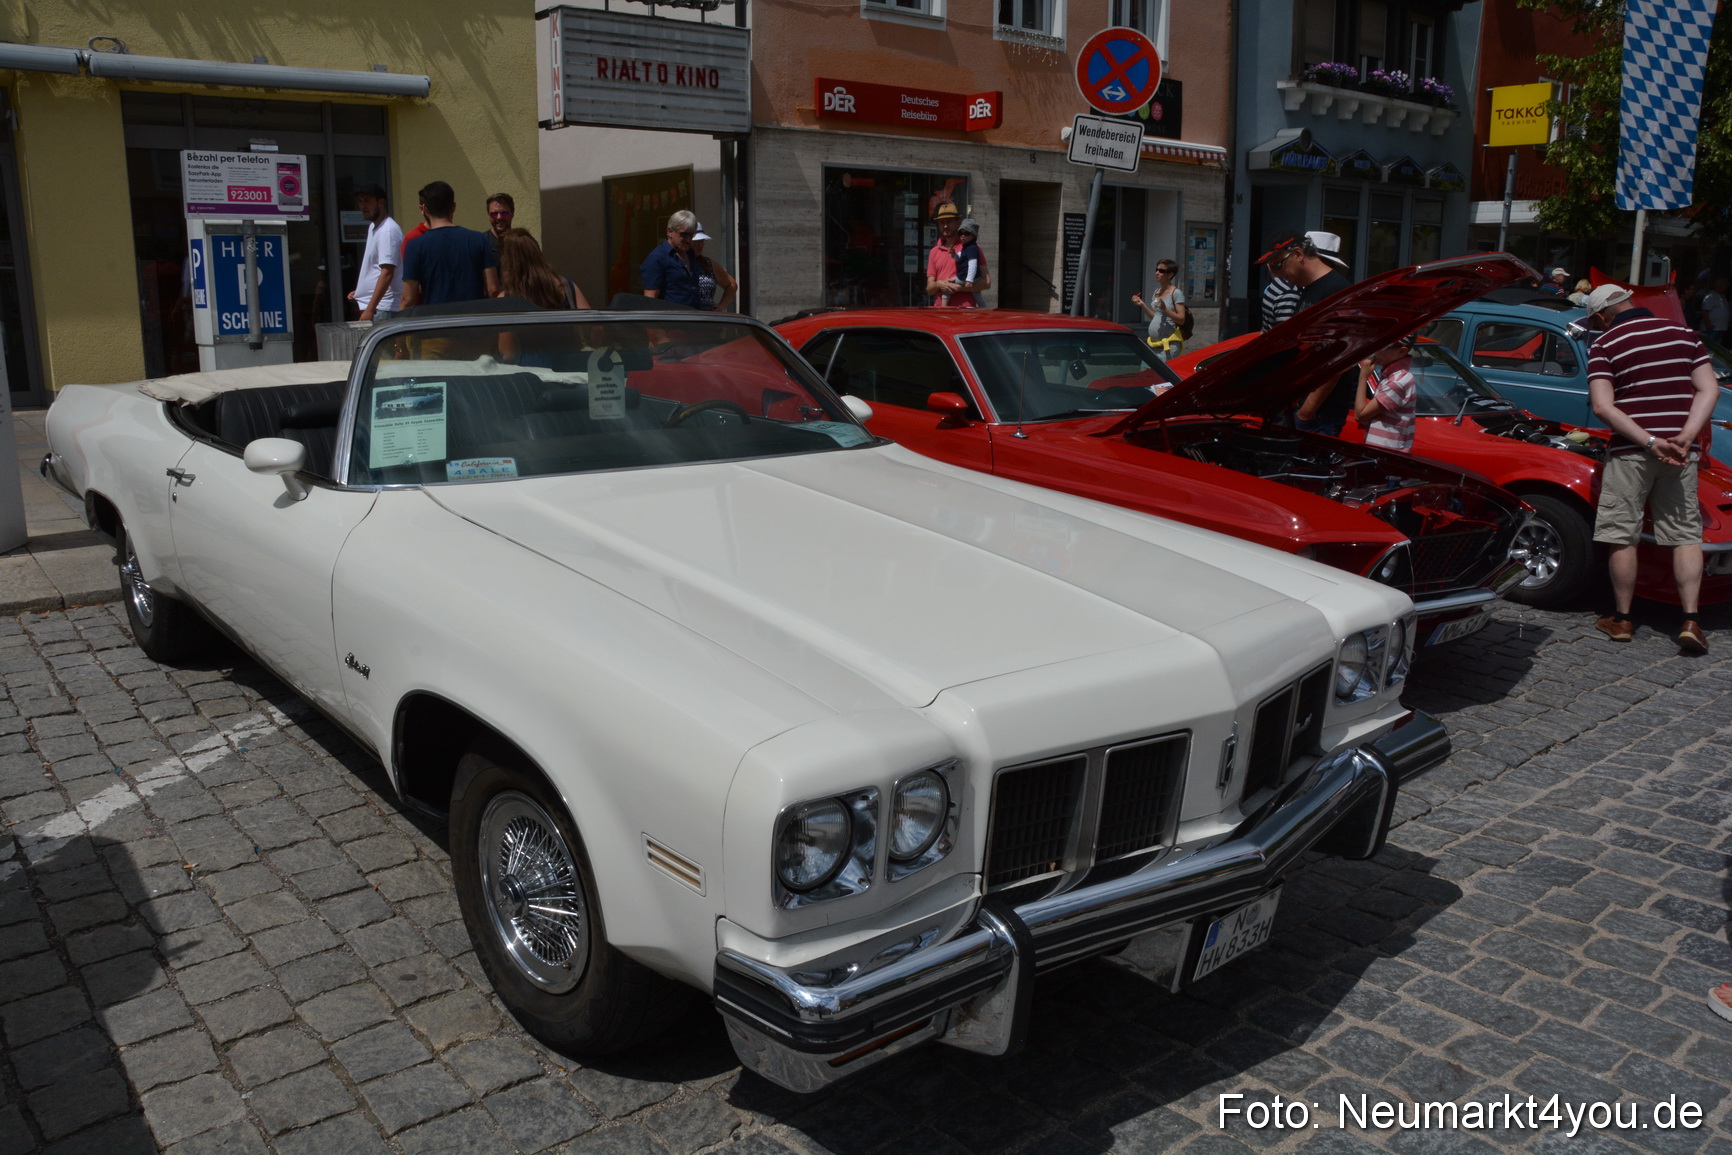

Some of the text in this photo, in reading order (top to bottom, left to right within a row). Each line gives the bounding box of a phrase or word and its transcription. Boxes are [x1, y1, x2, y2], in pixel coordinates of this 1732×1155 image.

[552, 14, 561, 117] KINO
[597, 57, 719, 88] RIALTO KINO
[901, 94, 939, 107] Deutsches
[901, 109, 938, 122] Reisebüro
[1079, 124, 1136, 144] Wendebereich
[187, 153, 270, 164] Bezahl per Telefon
[1029, 153, 1037, 164] 15
[1085, 143, 1124, 160] freihalten
[230, 191, 268, 200] 923001
[222, 311, 283, 330] SCHINE
[468, 467, 511, 475] SALE
[1232, 908, 1249, 935] N
[1225, 917, 1272, 960] 833H
